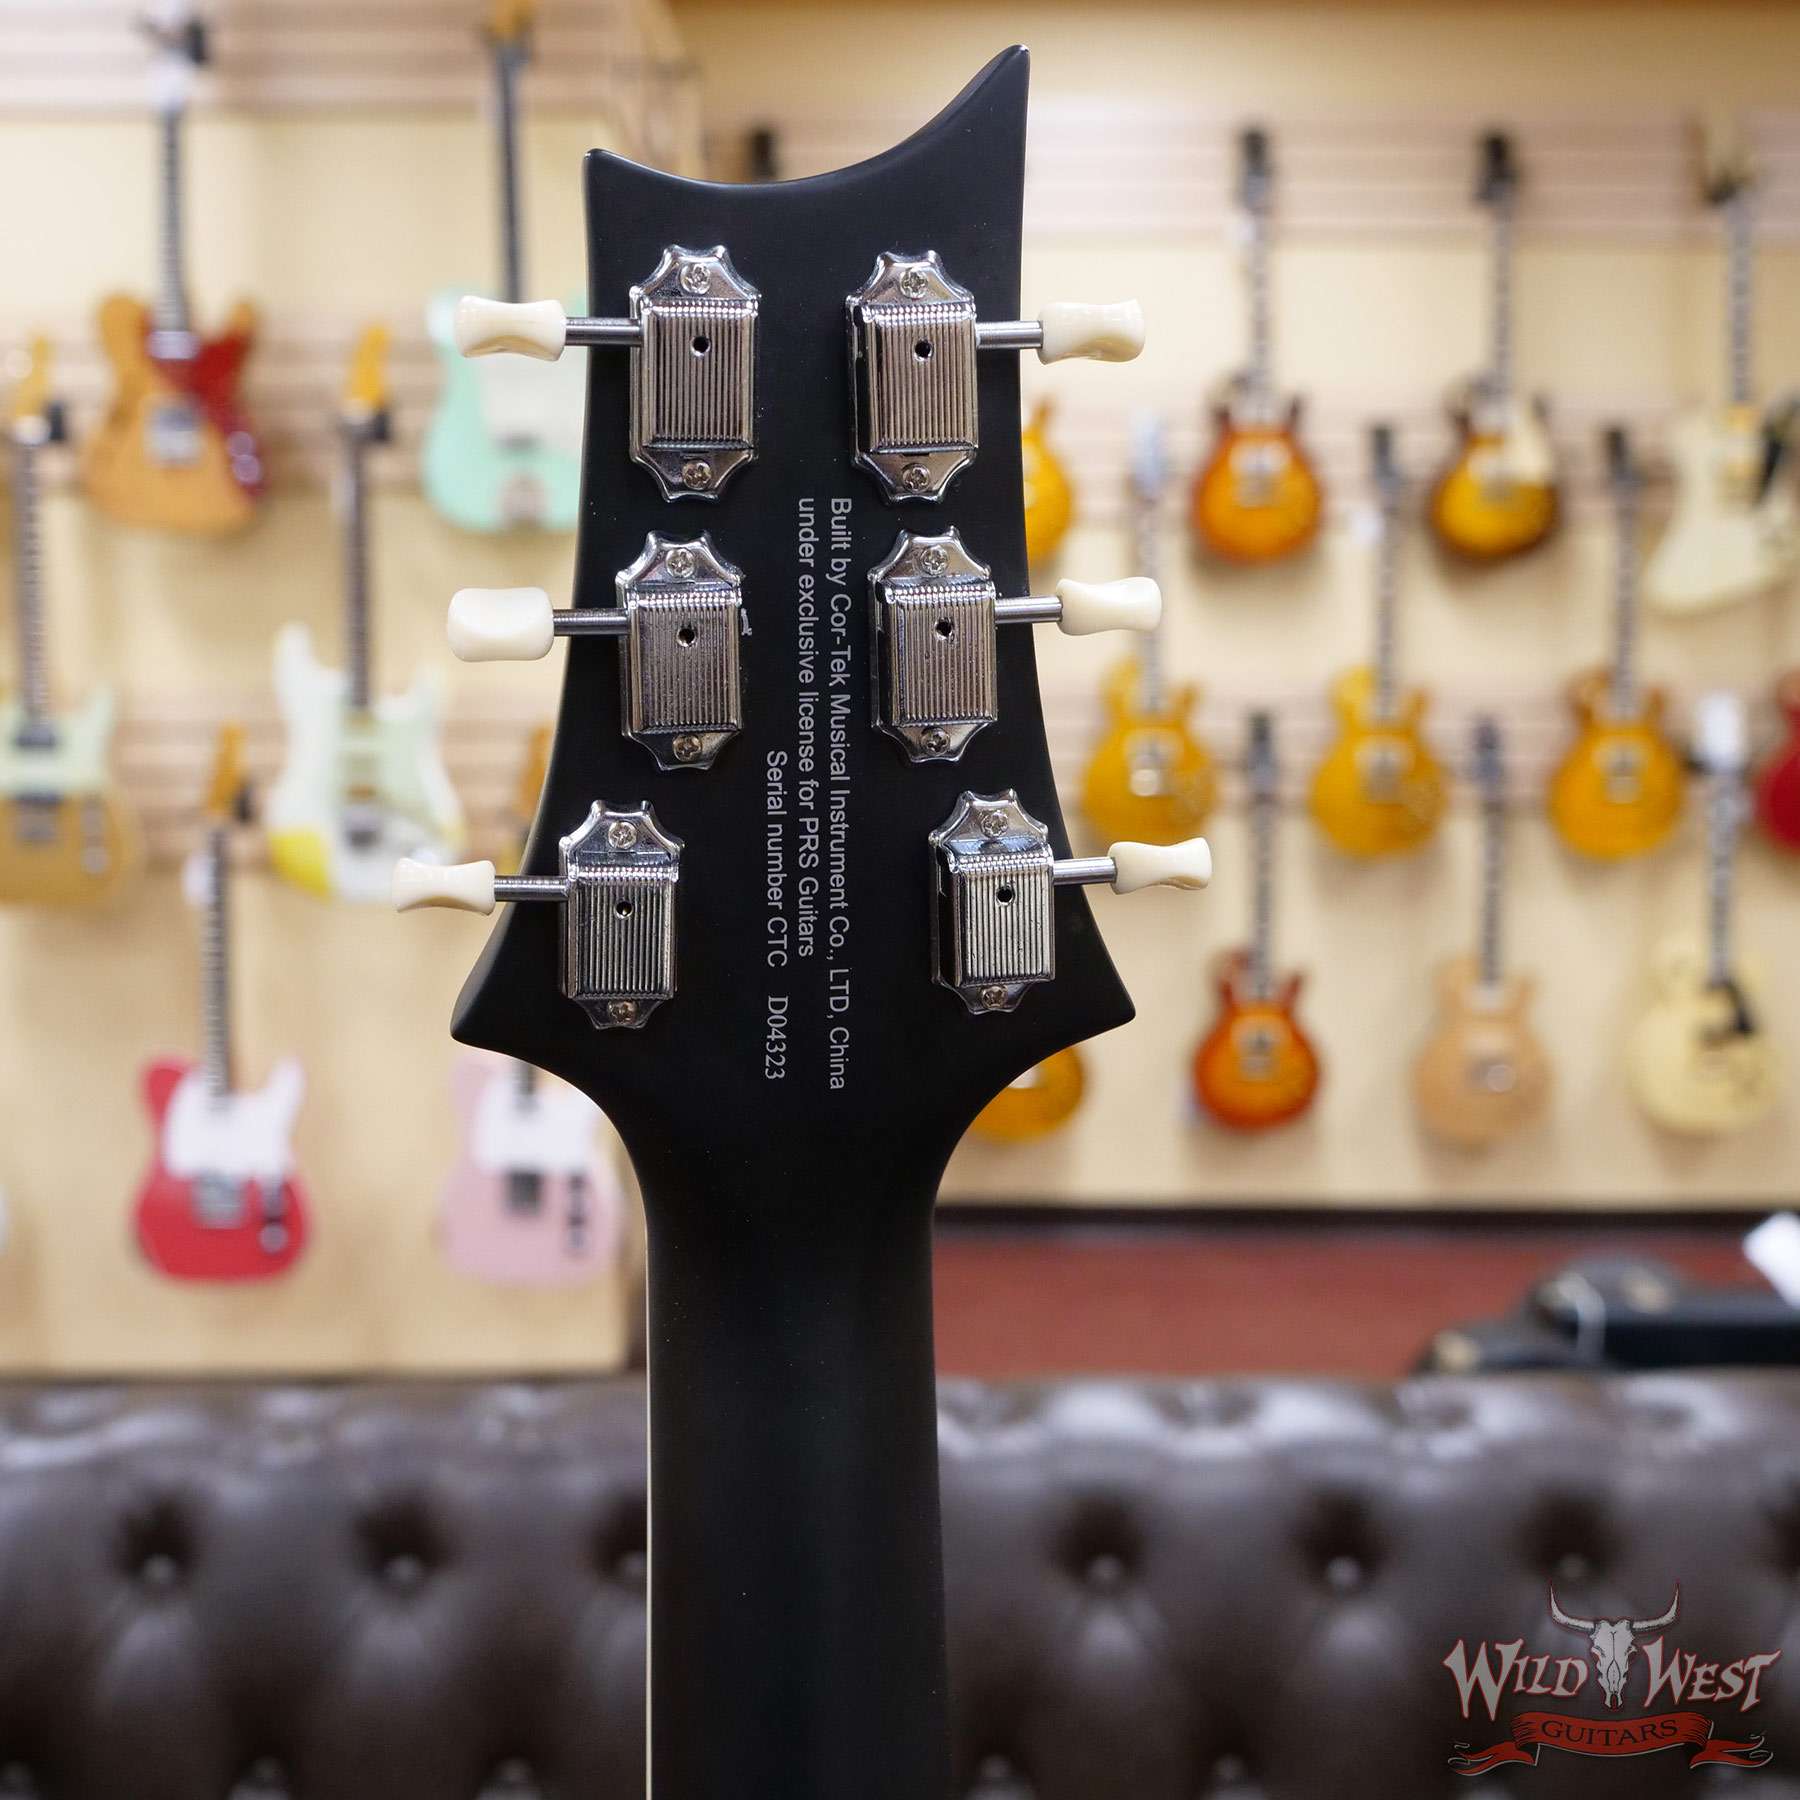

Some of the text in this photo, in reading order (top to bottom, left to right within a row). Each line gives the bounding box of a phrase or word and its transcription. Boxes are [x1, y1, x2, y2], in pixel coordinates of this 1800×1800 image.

[764, 750, 789, 1080] Serial number CTC D04323
[798, 497, 820, 957] under exclusive license for PRS Guitars
[825, 498, 852, 1090] Built by Cor-Tek Musical Instrument Co., LTD, China
